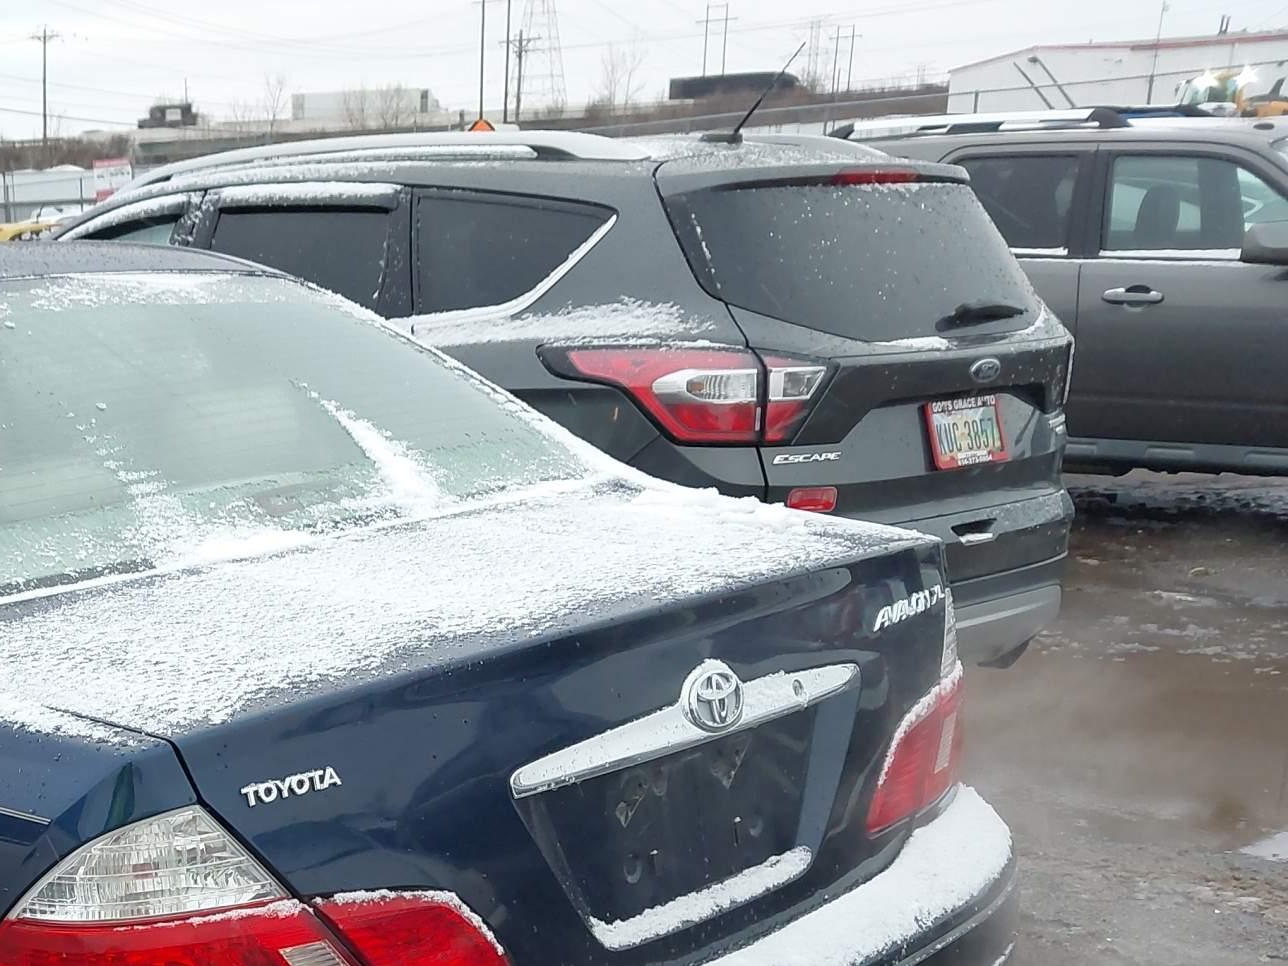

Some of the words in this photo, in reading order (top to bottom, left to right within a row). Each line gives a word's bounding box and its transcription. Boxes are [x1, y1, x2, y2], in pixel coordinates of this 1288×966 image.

[953, 397, 977, 410] GRACE
[936, 422, 962, 455] KUC
[964, 417, 996, 450] 3857
[772, 452, 842, 465] ESCAPE
[240, 765, 342, 808] TOYOTA
